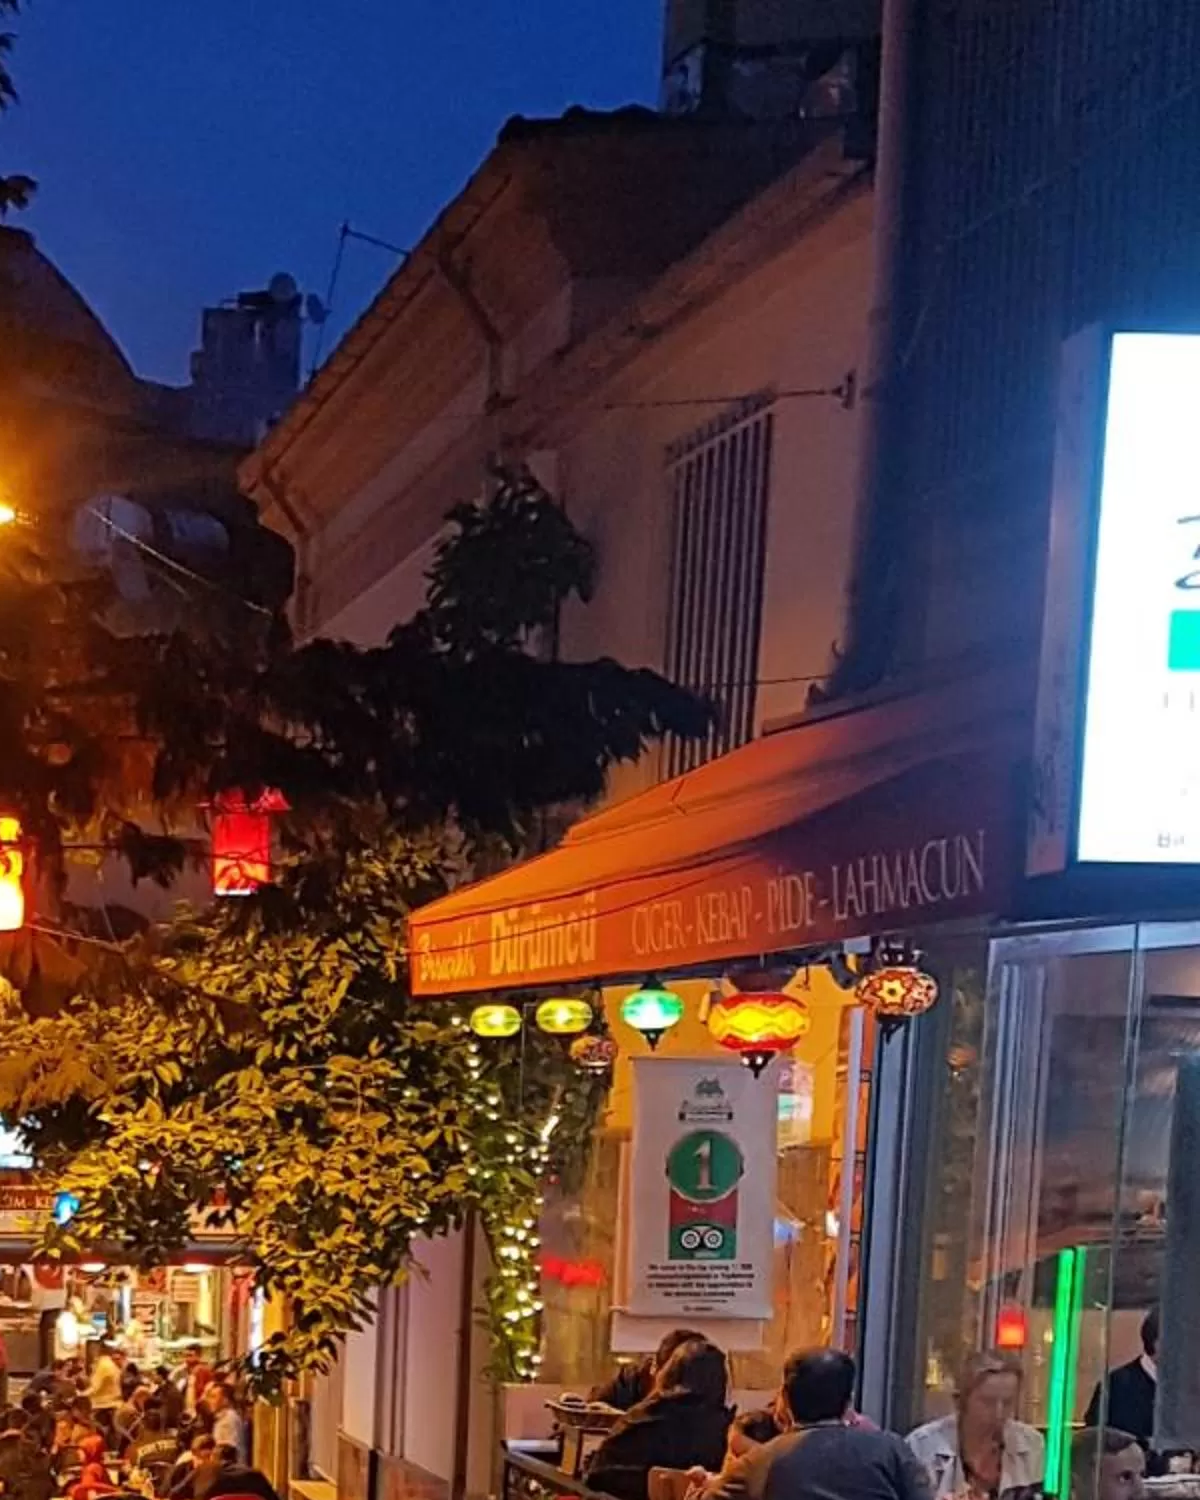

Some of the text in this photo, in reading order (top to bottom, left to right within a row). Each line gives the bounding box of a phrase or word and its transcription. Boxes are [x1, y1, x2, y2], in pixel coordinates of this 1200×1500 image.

[490, 891, 597, 976] Dürümcü
[695, 886, 752, 945] KEBAP
[832, 830, 985, 922] LAHMACUN
[692, 1139, 716, 1189] 1
